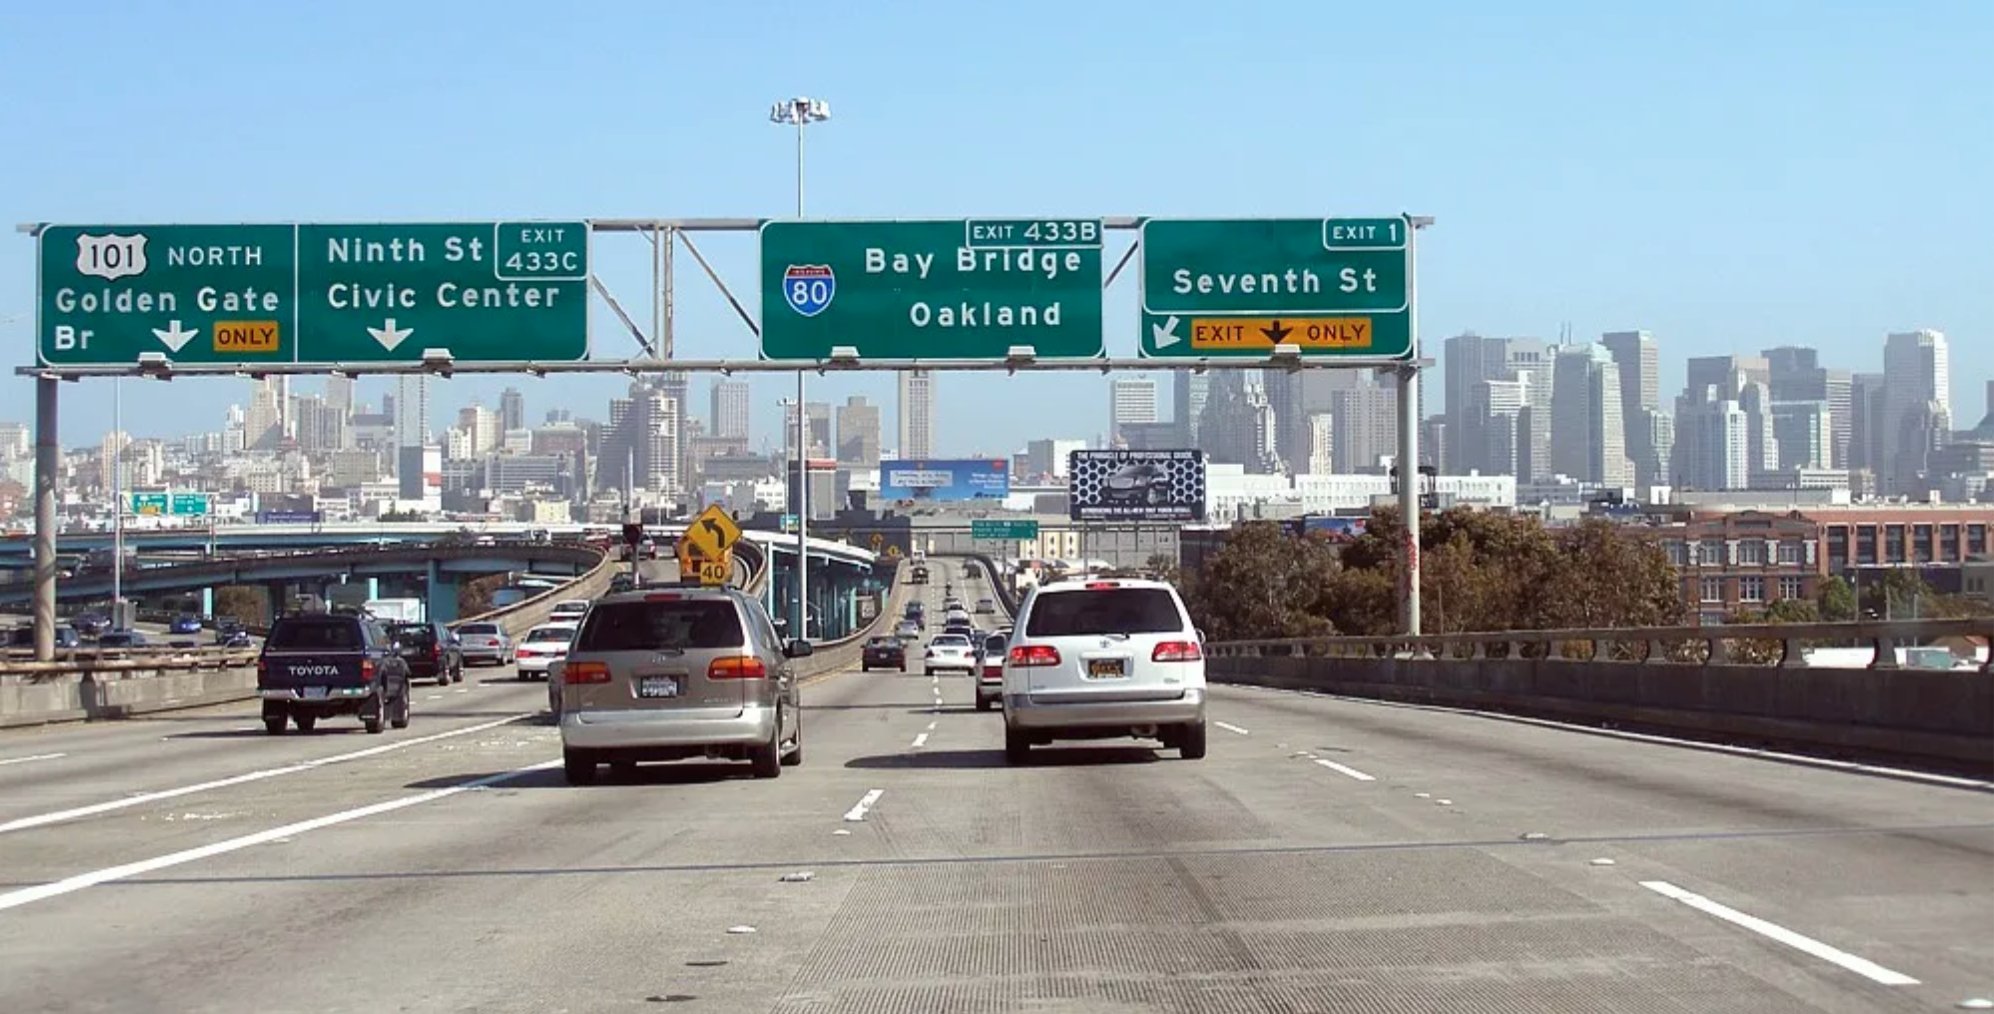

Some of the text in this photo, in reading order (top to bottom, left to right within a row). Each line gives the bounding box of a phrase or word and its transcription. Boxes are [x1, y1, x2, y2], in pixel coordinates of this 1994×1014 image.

[521, 228, 565, 243] EXIT
[973, 222, 1097, 241] EXIT 433B
[1332, 223, 1397, 242] EXIT 1
[90, 243, 134, 268] 101
[168, 246, 262, 266] NORTH
[328, 236, 483, 263] Ninth St
[505, 252, 577, 272] 433C
[865, 247, 1081, 279] Bay Bridge
[1173, 267, 1376, 294] Seventh St
[55, 286, 279, 313] Golden Gate
[328, 280, 560, 309] Civic Center
[791, 280, 829, 305] 80
[910, 302, 1060, 327] Oakland
[55, 325, 94, 350] Br
[217, 327, 275, 345] ONLY
[1195, 323, 1366, 342] EXIT ONLY
[701, 563, 725, 581] 40
[288, 665, 340, 676] TOYOTA
